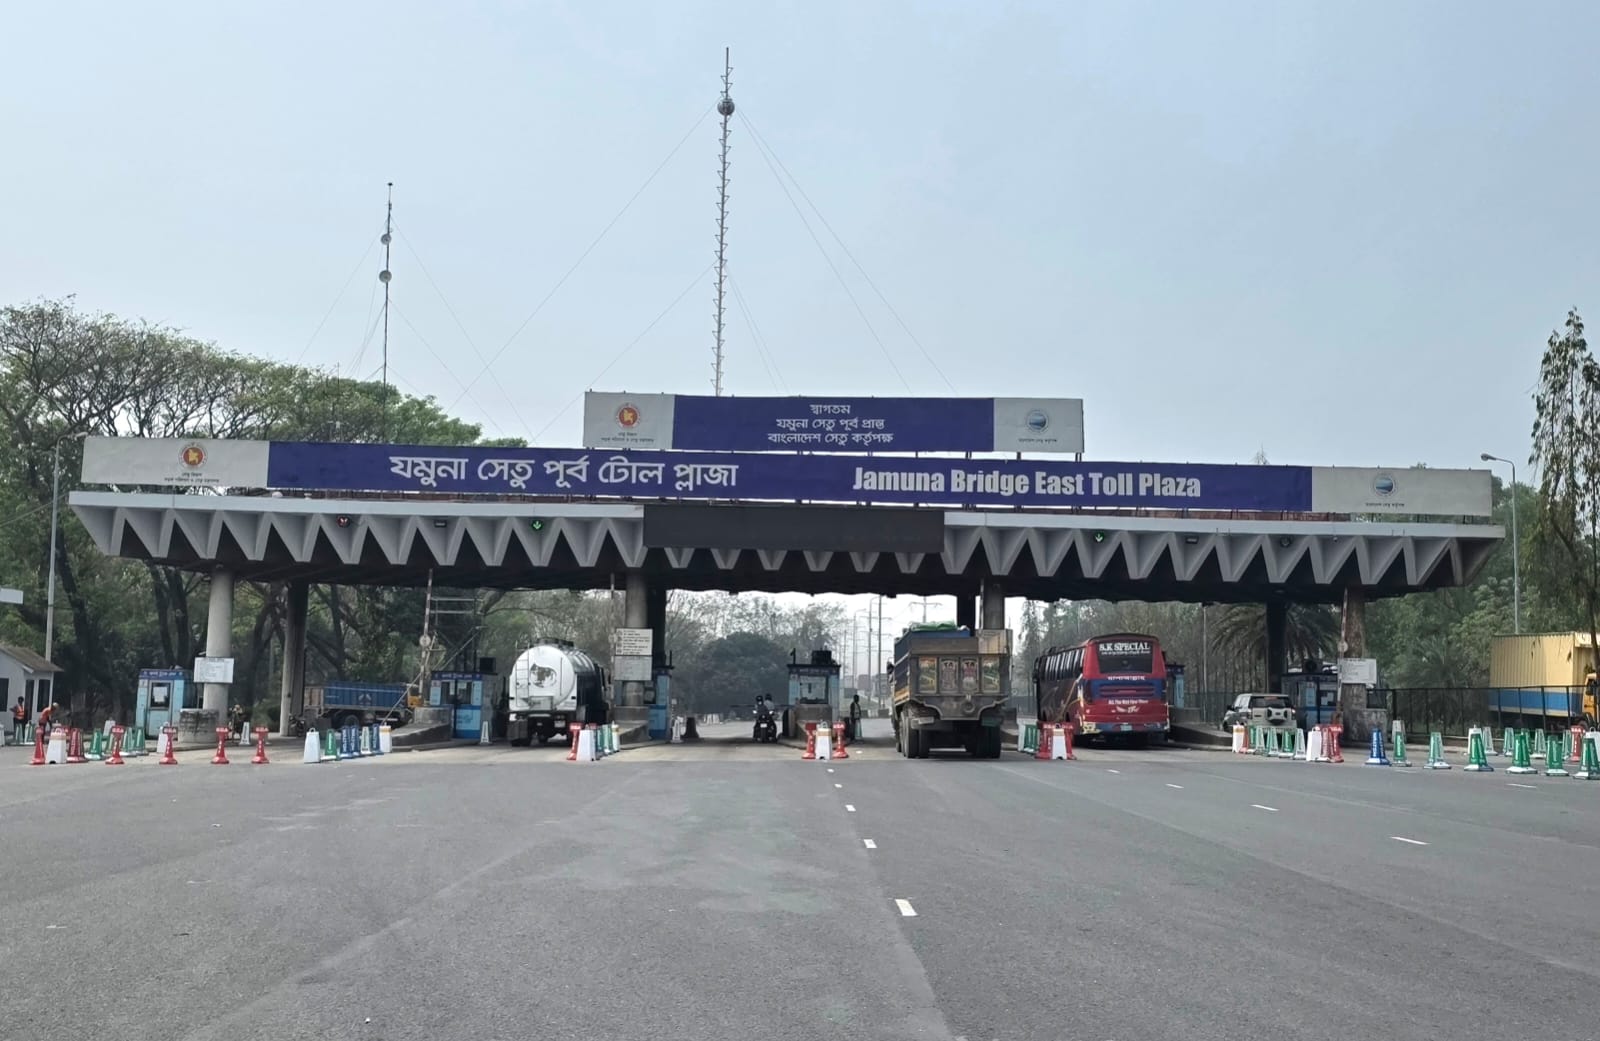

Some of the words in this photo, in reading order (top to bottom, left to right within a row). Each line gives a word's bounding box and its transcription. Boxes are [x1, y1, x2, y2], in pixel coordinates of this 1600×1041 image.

[809, 404, 851, 415] স্বাগতম
[776, 418, 808, 432] যমুনা
[812, 419, 836, 432] সেতু
[840, 417, 858, 431] পূর্ব
[861, 418, 885, 430] প্রান্ত
[768, 432, 821, 444] বাংলাদেশ
[825, 432, 848, 446] সেতু
[852, 431, 894, 446] কর্তৃপক্ষ
[389, 455, 469, 488] যমুনা
[477, 458, 535, 490] সেতু
[543, 455, 591, 489] পূর্ব
[598, 455, 665, 485] টোল
[673, 463, 739, 492] প্লাজা
[852, 467, 945, 493] Jamuna
[951, 469, 1030, 497] Bridge
[1035, 471, 1084, 495] East
[1089, 472, 1133, 496] Toll
[1139, 473, 1202, 498] Plaza
[1114, 642, 1150, 651] SPECIAL
